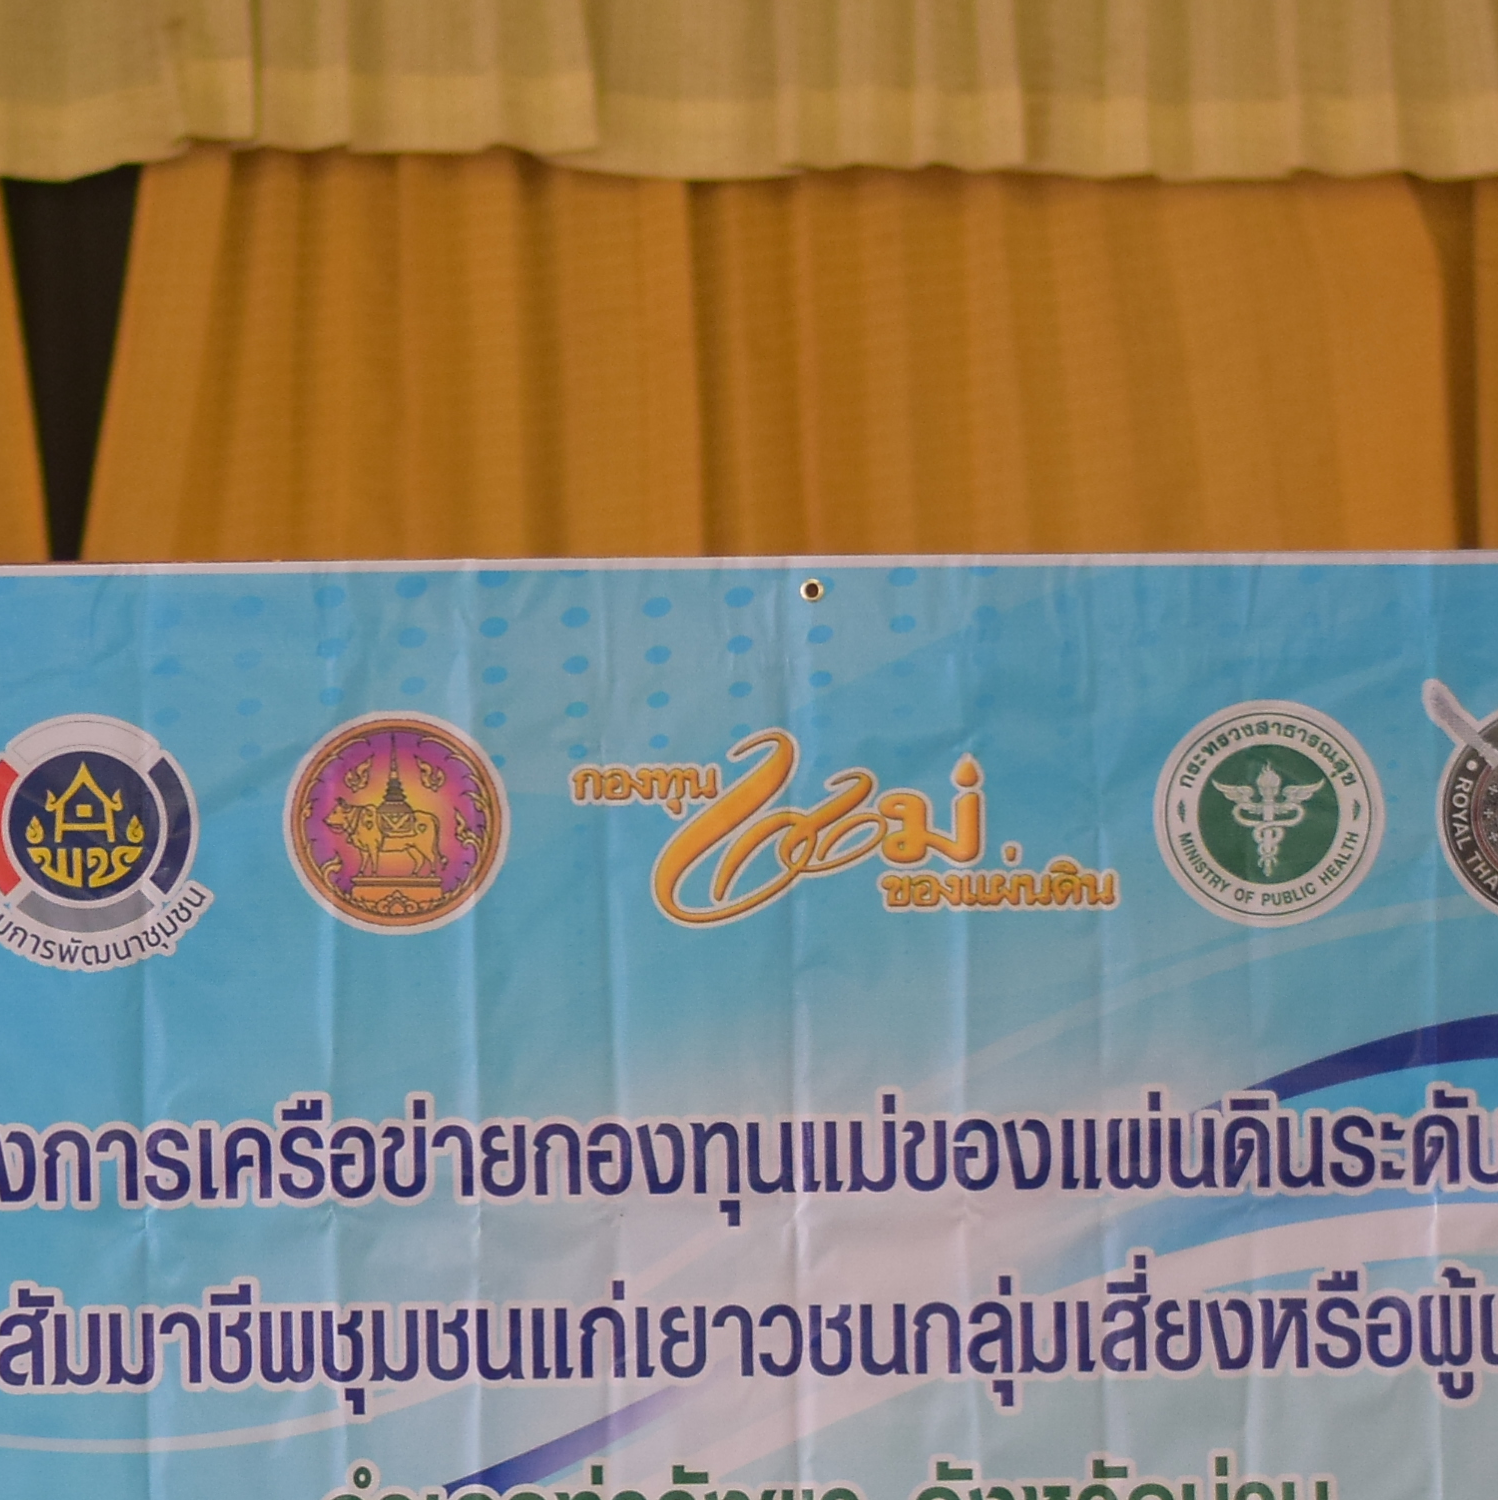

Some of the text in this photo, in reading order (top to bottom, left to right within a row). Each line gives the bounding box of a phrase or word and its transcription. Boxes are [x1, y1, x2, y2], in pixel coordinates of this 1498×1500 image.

[1178, 719, 1357, 790] กระทรวงสาธารณสุข
[572, 766, 717, 815] กองทุน
[1450, 776, 1474, 852] ROYAL
[881, 846, 1114, 907] ของแผ่นดิน
[1177, 831, 1360, 907] MINISTRY OF PUBLIC HEALTH
